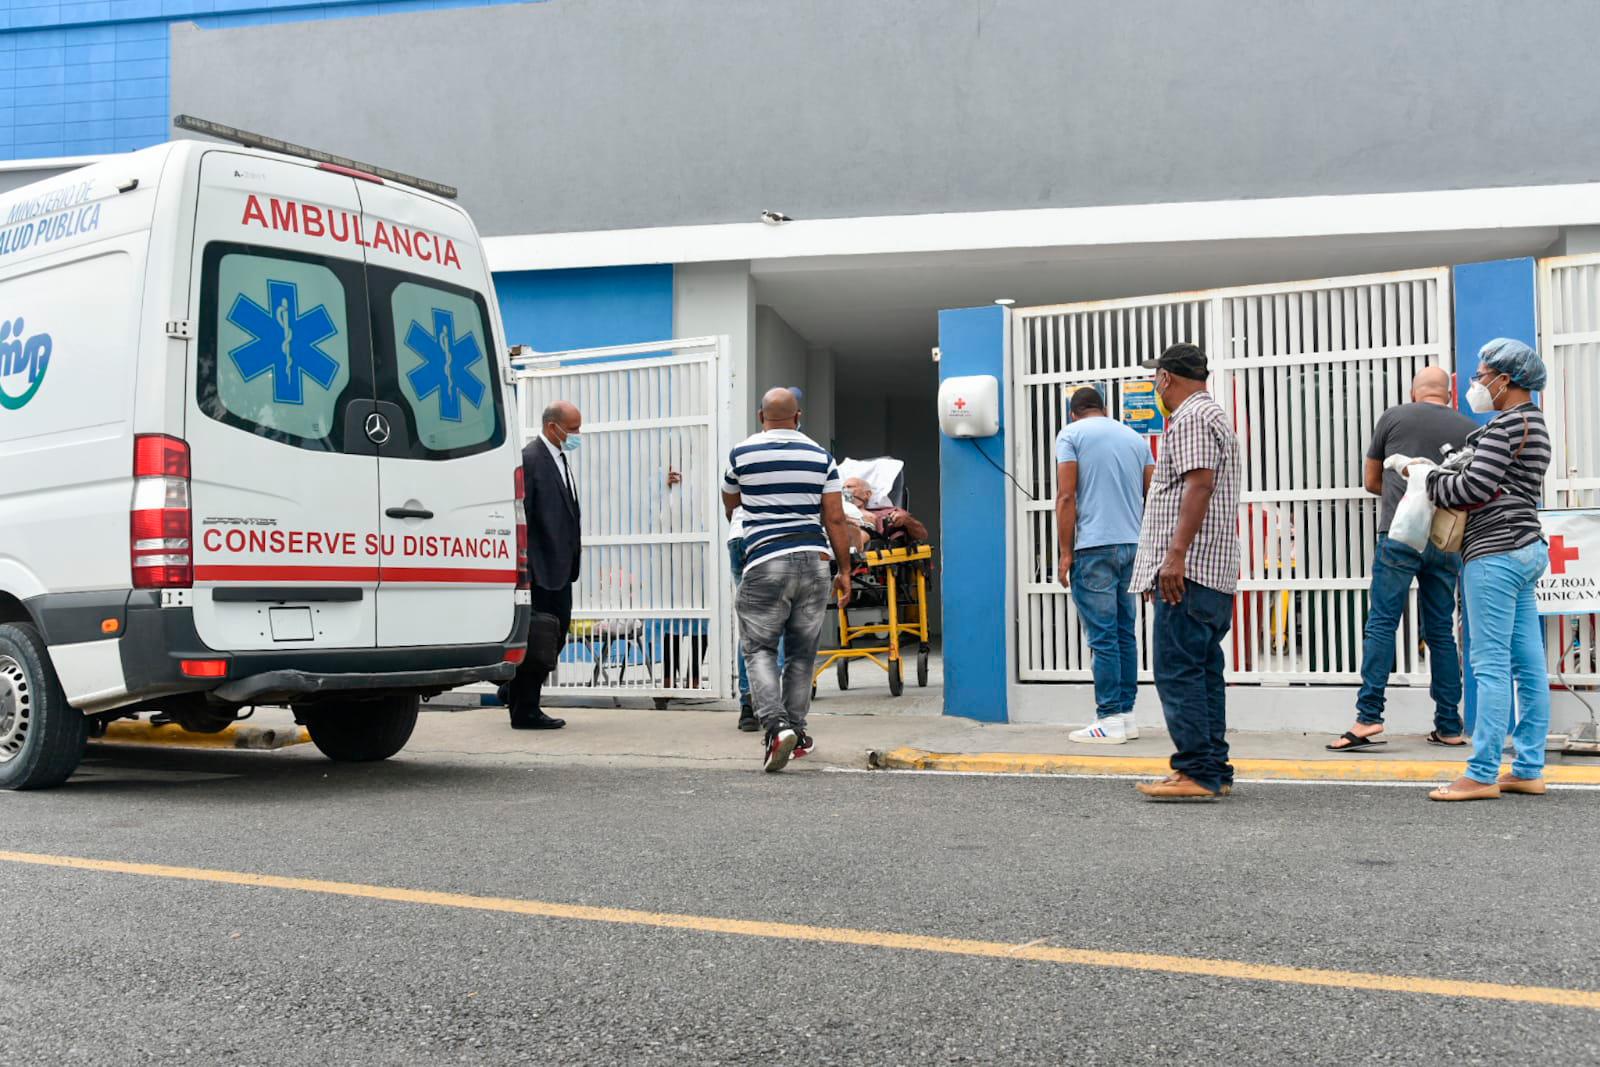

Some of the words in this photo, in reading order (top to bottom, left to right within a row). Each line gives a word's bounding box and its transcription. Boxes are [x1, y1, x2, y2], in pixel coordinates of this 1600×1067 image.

[0, 222, 34, 256] ALUD
[242, 194, 462, 270] AMBULANCIA
[203, 528, 357, 556] CONSERVE
[364, 533, 395, 556] SU
[403, 535, 510, 560] DISTANCIA
[1535, 578, 1558, 588] RUZ
[1561, 577, 1595, 588] ROJA
[1536, 590, 1600, 601] MINICANA
